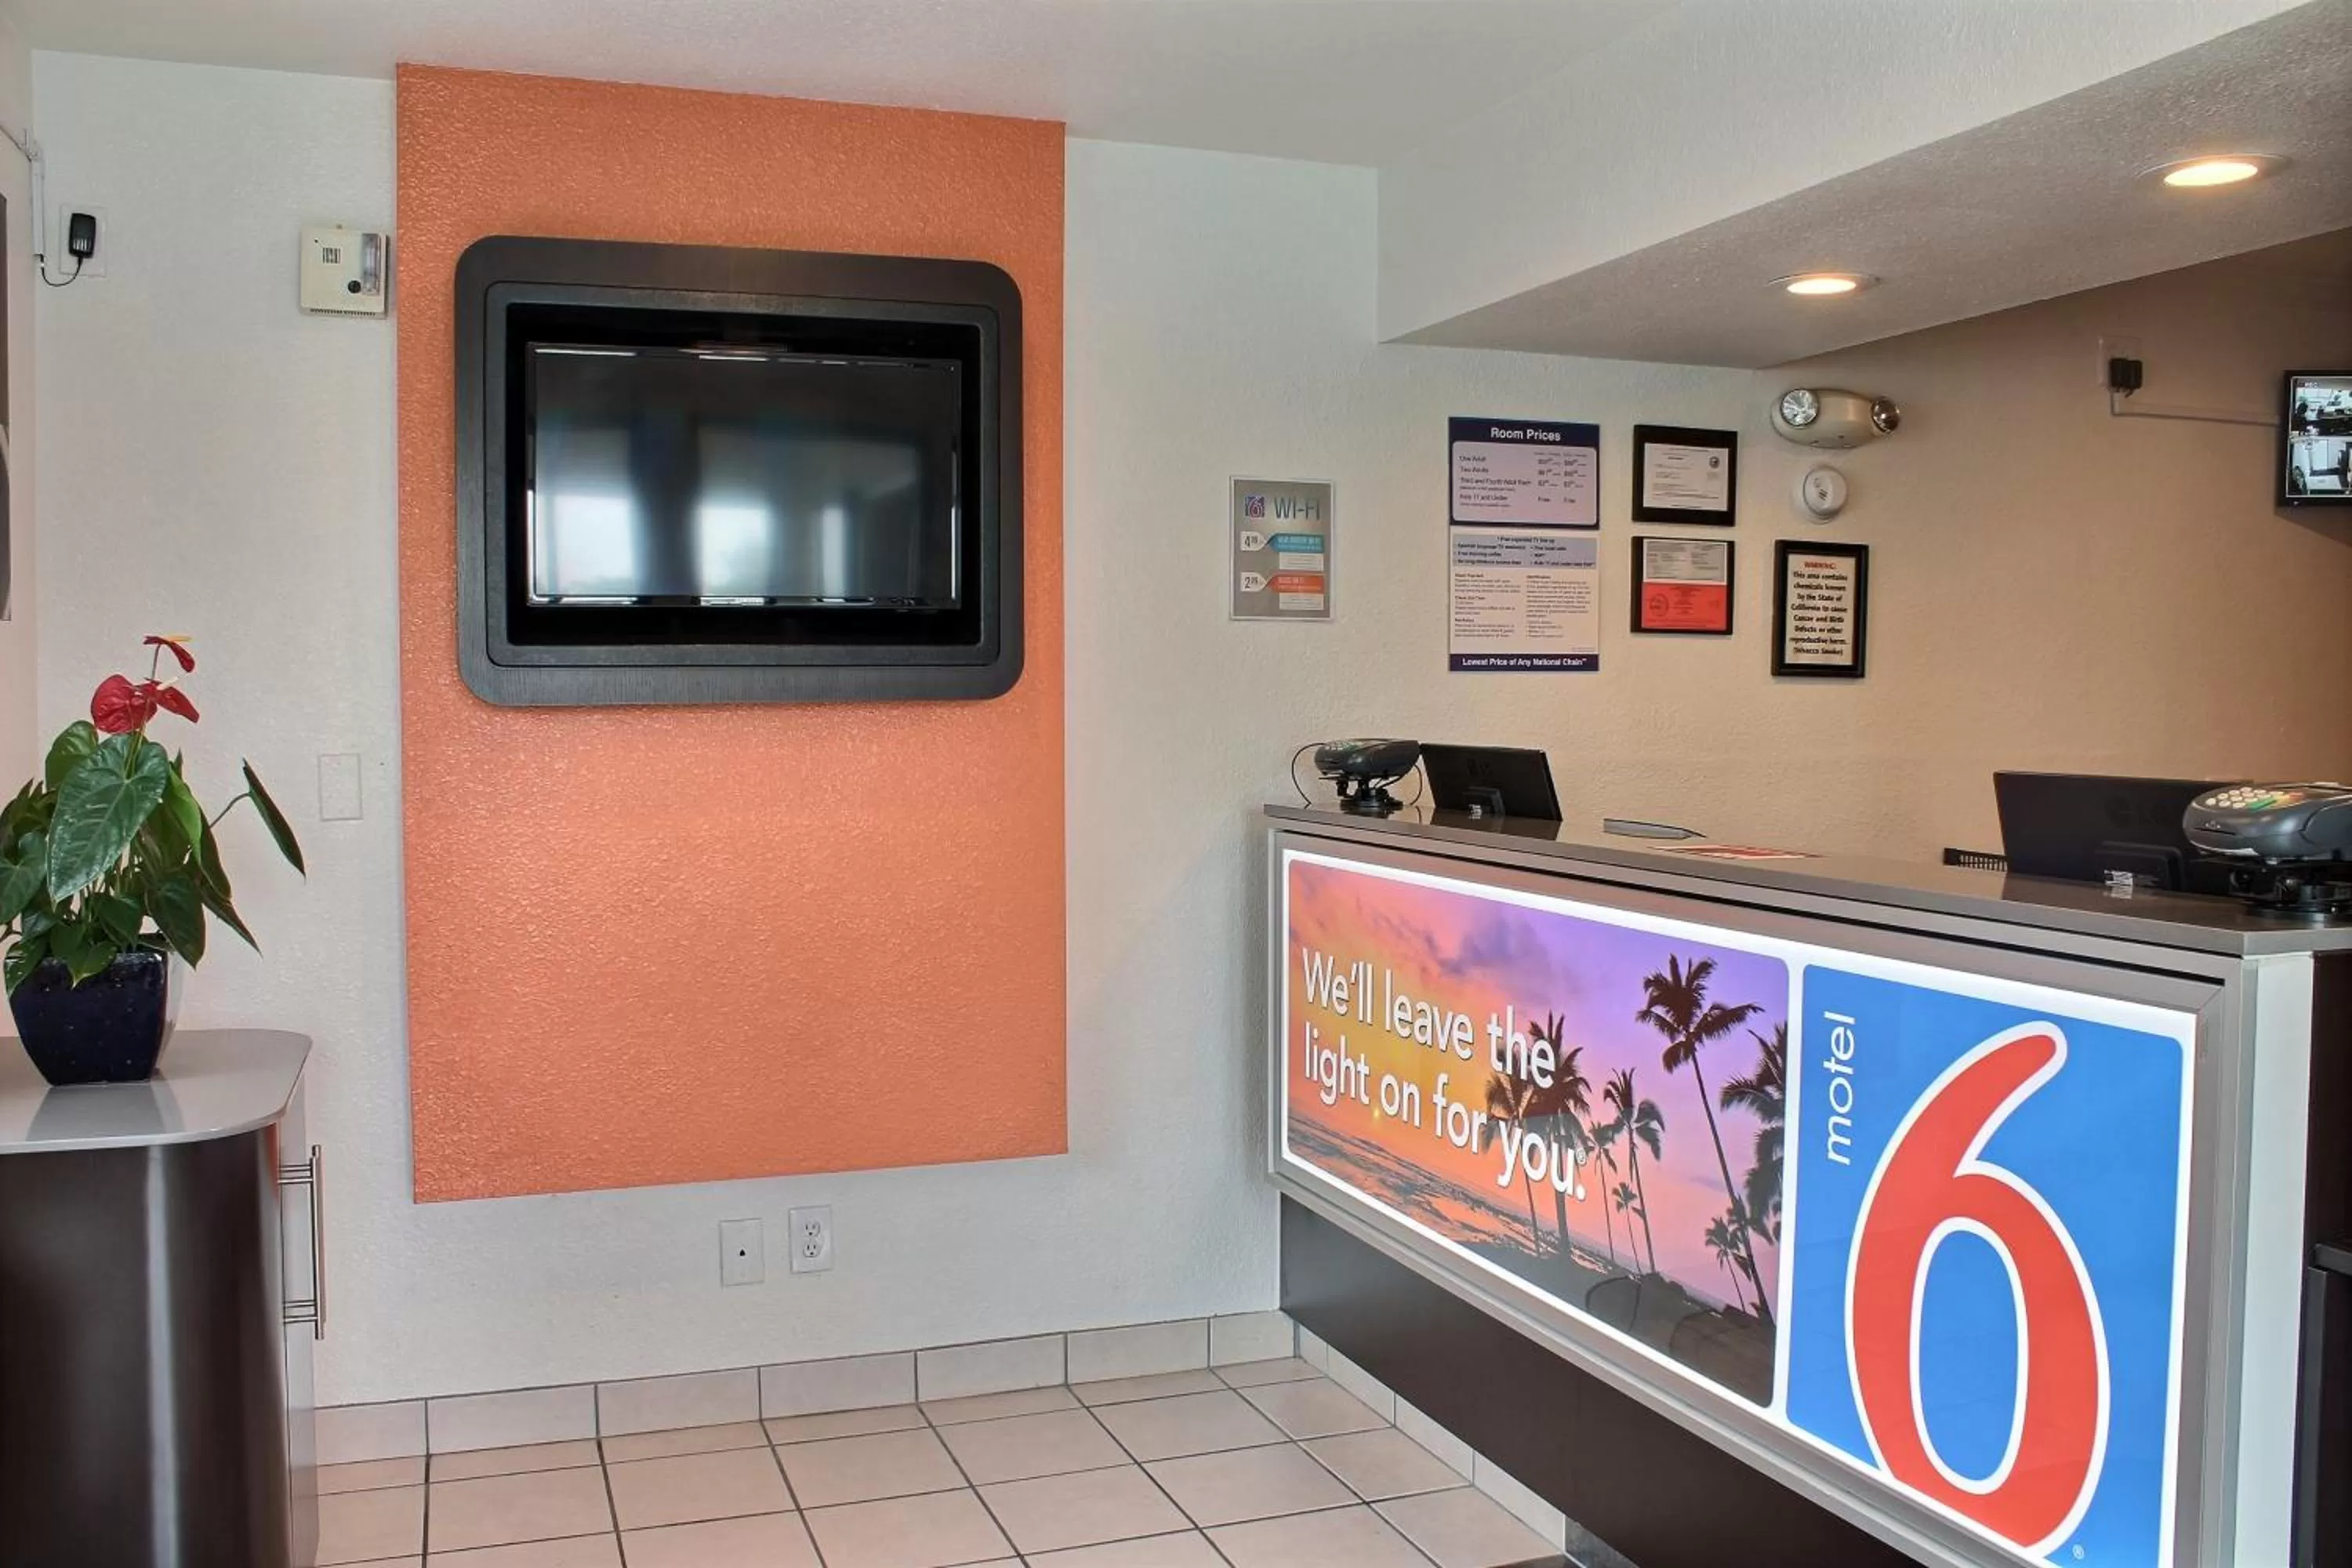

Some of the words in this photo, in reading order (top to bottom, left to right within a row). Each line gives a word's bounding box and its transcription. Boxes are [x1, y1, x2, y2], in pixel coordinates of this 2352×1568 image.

[1490, 427, 1523, 439] Room
[1526, 429, 1561, 441] Prices
[1518, 658, 1531, 668] Any
[1302, 947, 1374, 1025] We'll
[1385, 968, 1475, 1060] leave
[1487, 1004, 1556, 1089] the
[1305, 1022, 1370, 1105] light
[1380, 1073, 1421, 1128] on
[1432, 1072, 1487, 1154] for
[1822, 1010, 1857, 1167] motel
[1844, 1020, 2111, 1559] 6
